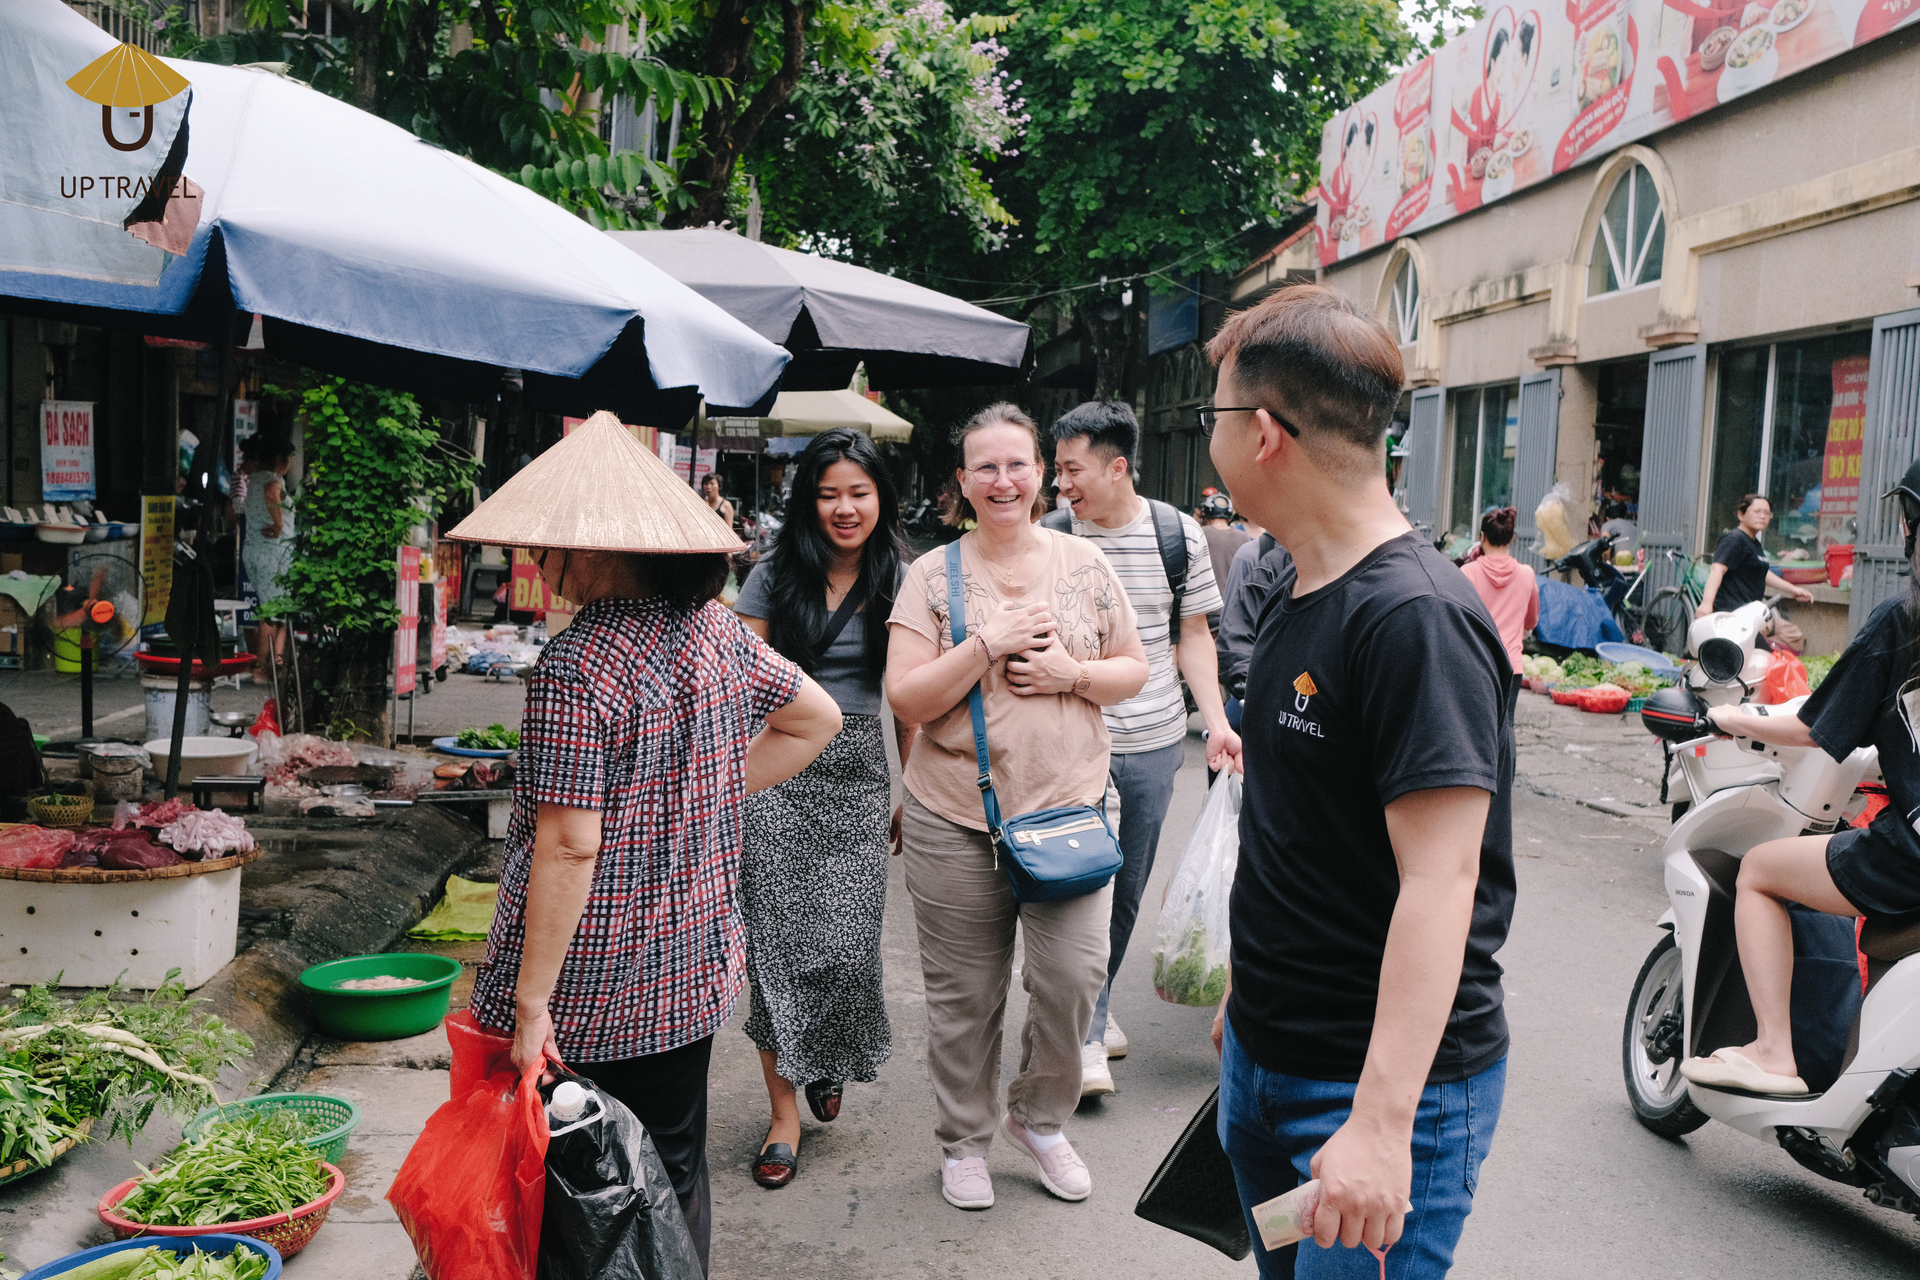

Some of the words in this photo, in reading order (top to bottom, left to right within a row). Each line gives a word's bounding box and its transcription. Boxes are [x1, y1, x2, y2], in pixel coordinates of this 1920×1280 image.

[949, 560, 960, 598] JIELSHI
[1287, 713, 1325, 738] TRAVEL
[1675, 889, 1695, 897] HONDA
